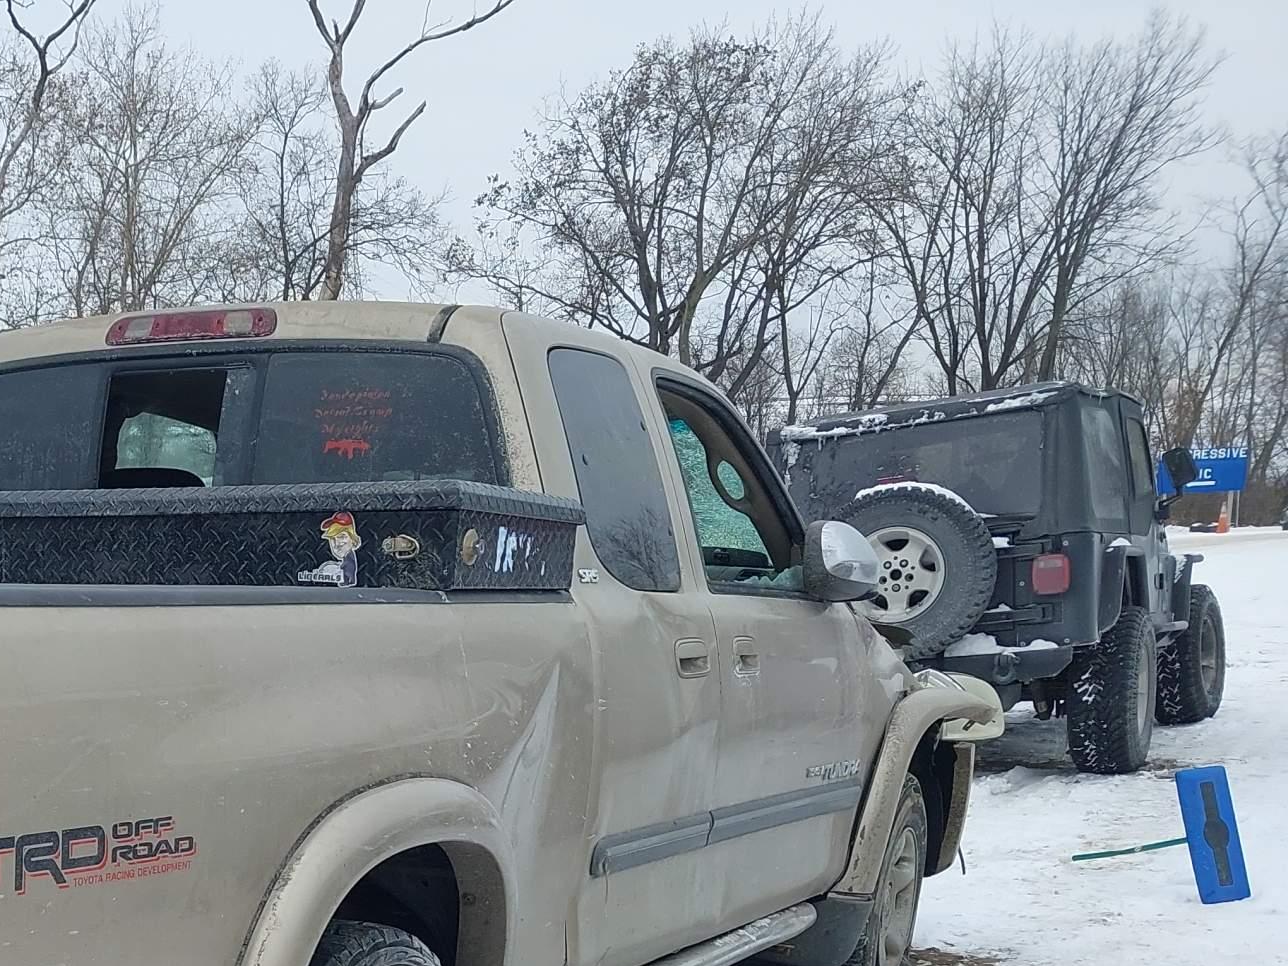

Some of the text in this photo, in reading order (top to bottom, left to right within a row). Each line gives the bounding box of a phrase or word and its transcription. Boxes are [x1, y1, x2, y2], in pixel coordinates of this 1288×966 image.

[1192, 447, 1248, 460] RESSIVE
[1198, 468, 1213, 479] IC
[112, 816, 174, 843] OFF
[111, 836, 196, 867] ROAD
[73, 861, 194, 887] TOYOTA RACING DEVELOPMENT
